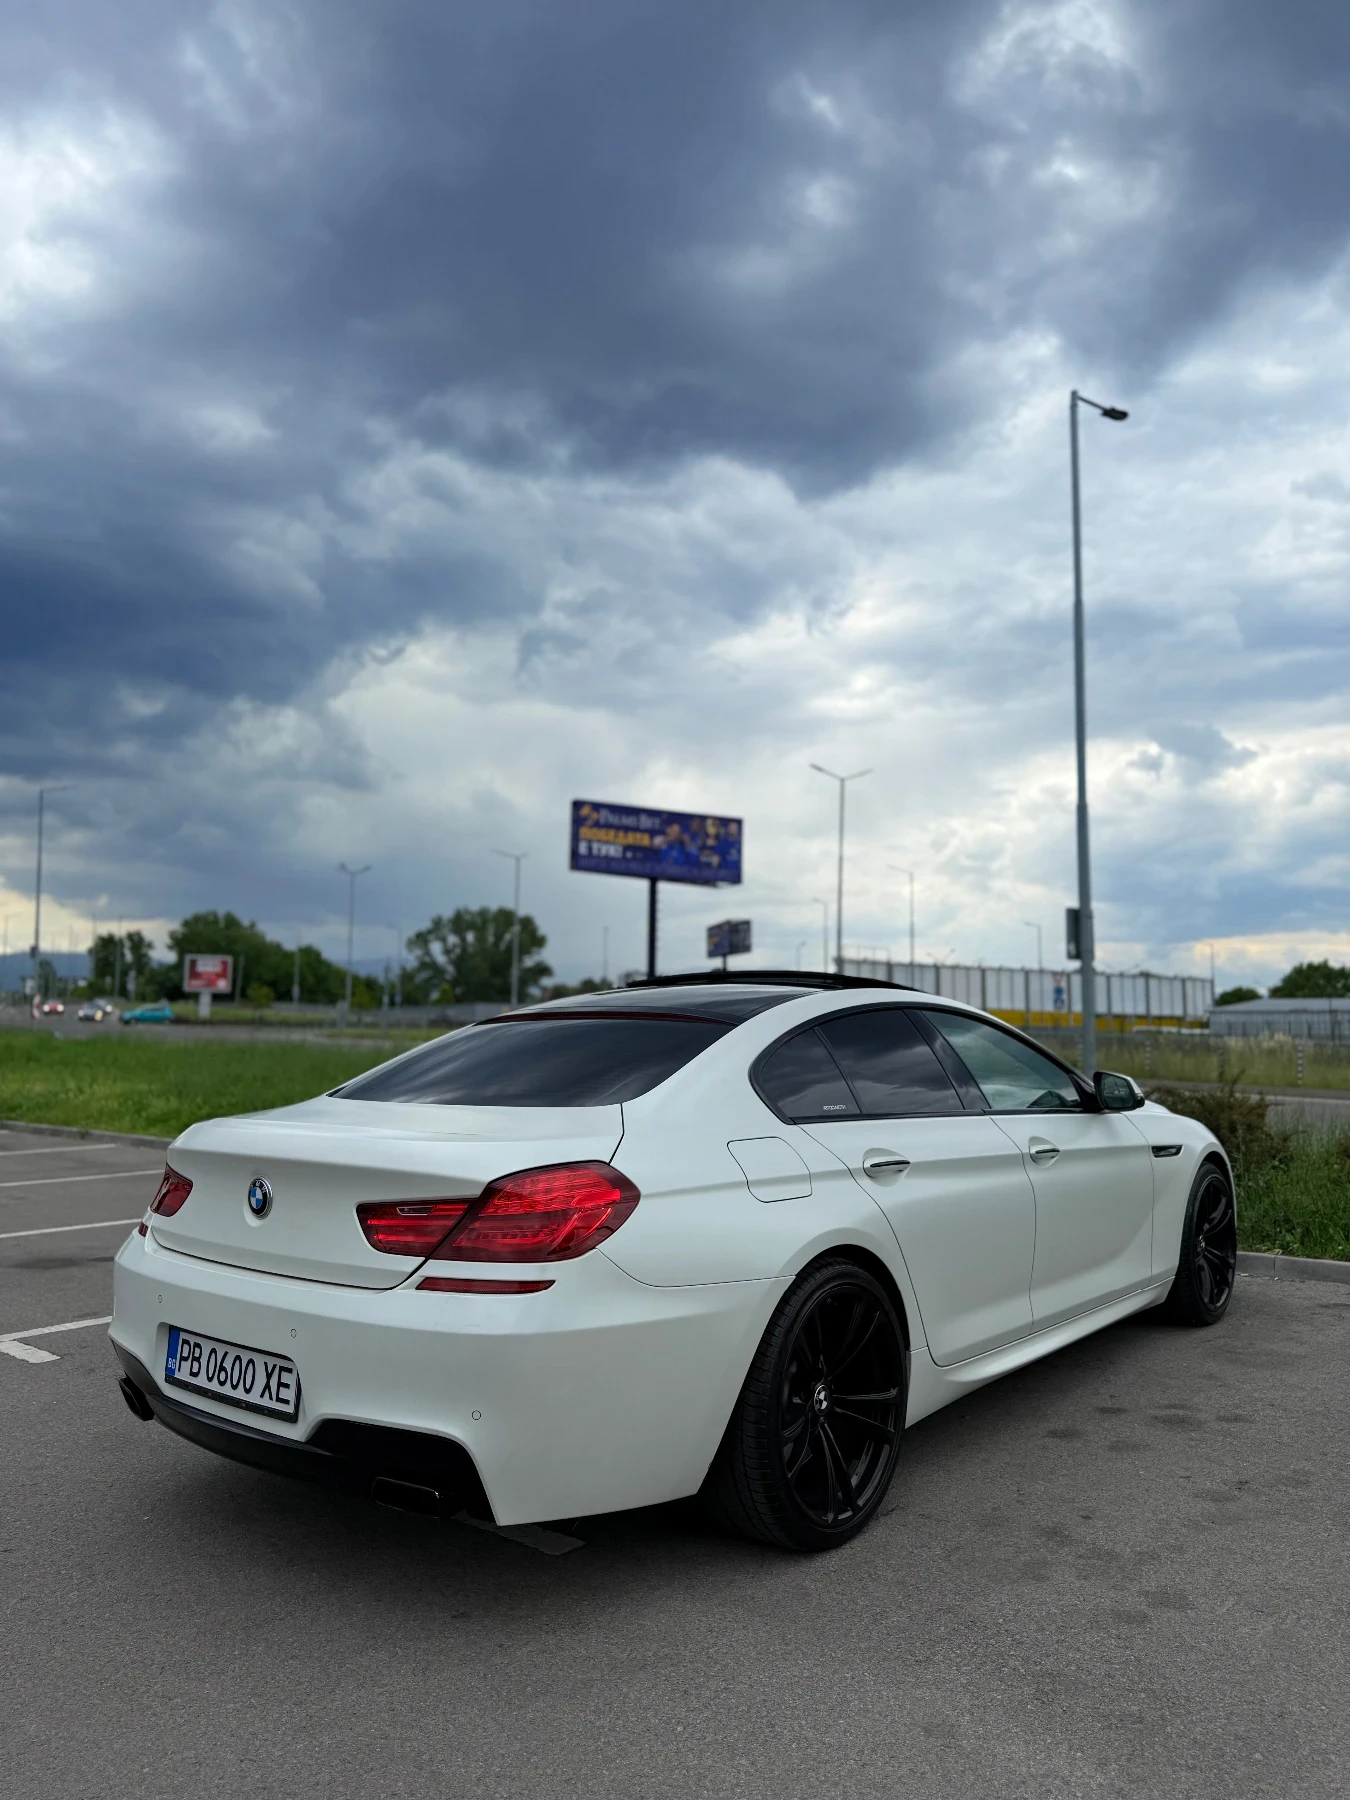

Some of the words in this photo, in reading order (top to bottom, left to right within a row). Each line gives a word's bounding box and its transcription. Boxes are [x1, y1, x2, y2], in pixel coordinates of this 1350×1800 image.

[167, 1357, 176, 1370] BG
[177, 1338, 203, 1378] PB
[206, 1347, 256, 1395] 0600
[259, 1360, 294, 1406] XE
